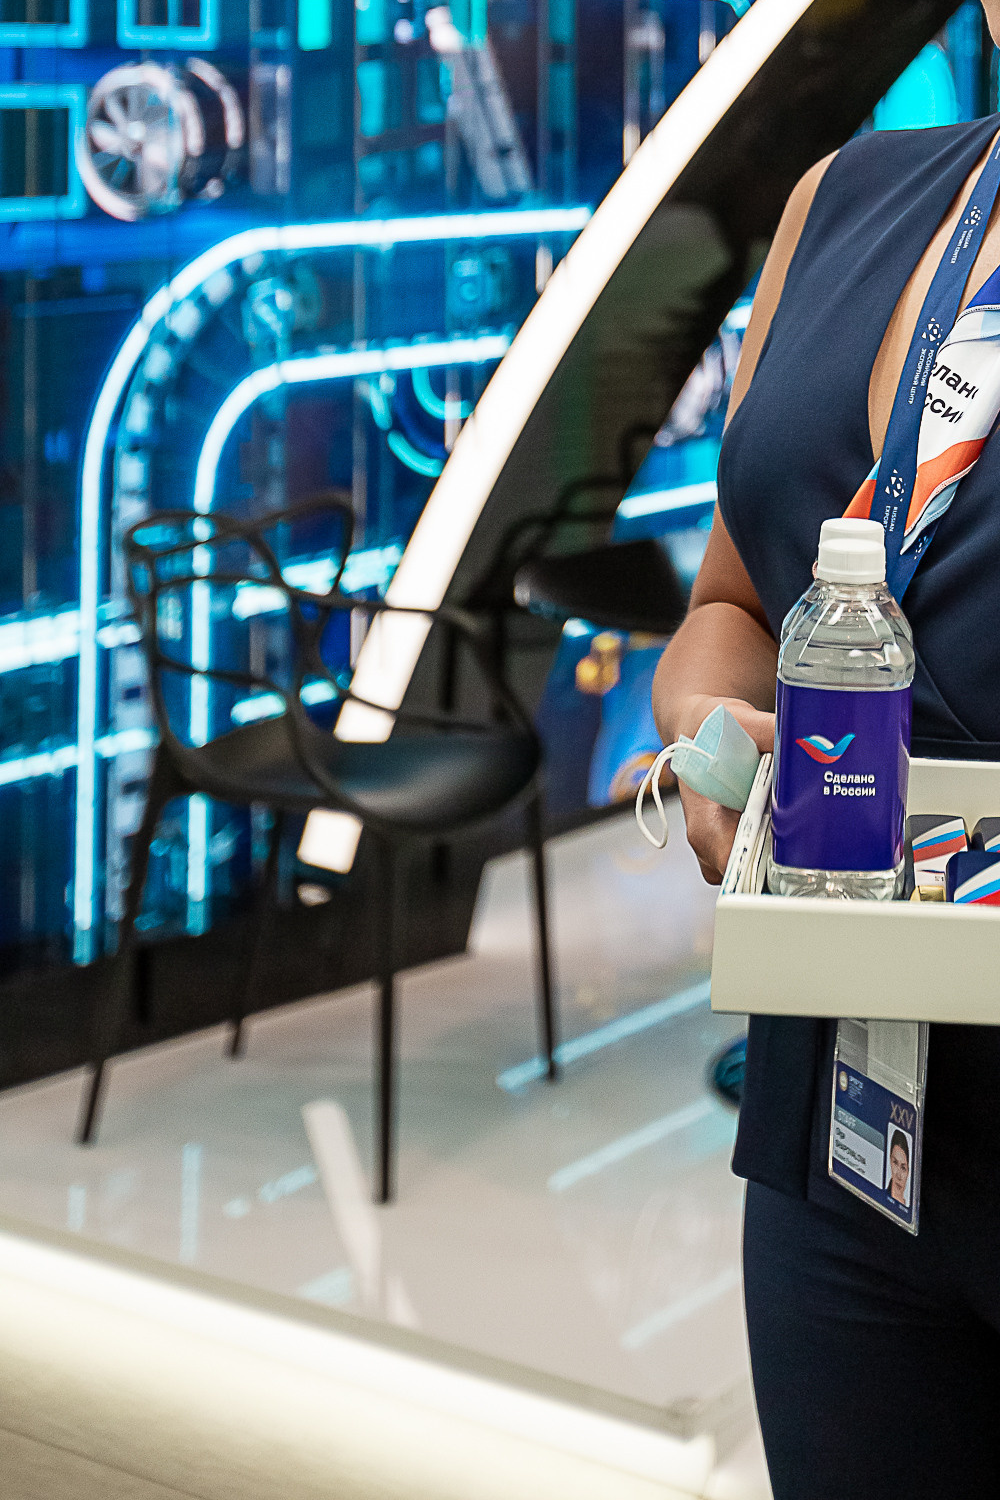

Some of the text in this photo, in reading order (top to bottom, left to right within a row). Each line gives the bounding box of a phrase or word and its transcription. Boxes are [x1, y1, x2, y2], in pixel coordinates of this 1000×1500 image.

[933, 362, 979, 399] лан
[823, 770, 875, 784] Сделано
[823, 783, 876, 797] в России
[890, 1101, 914, 1130] XXV
